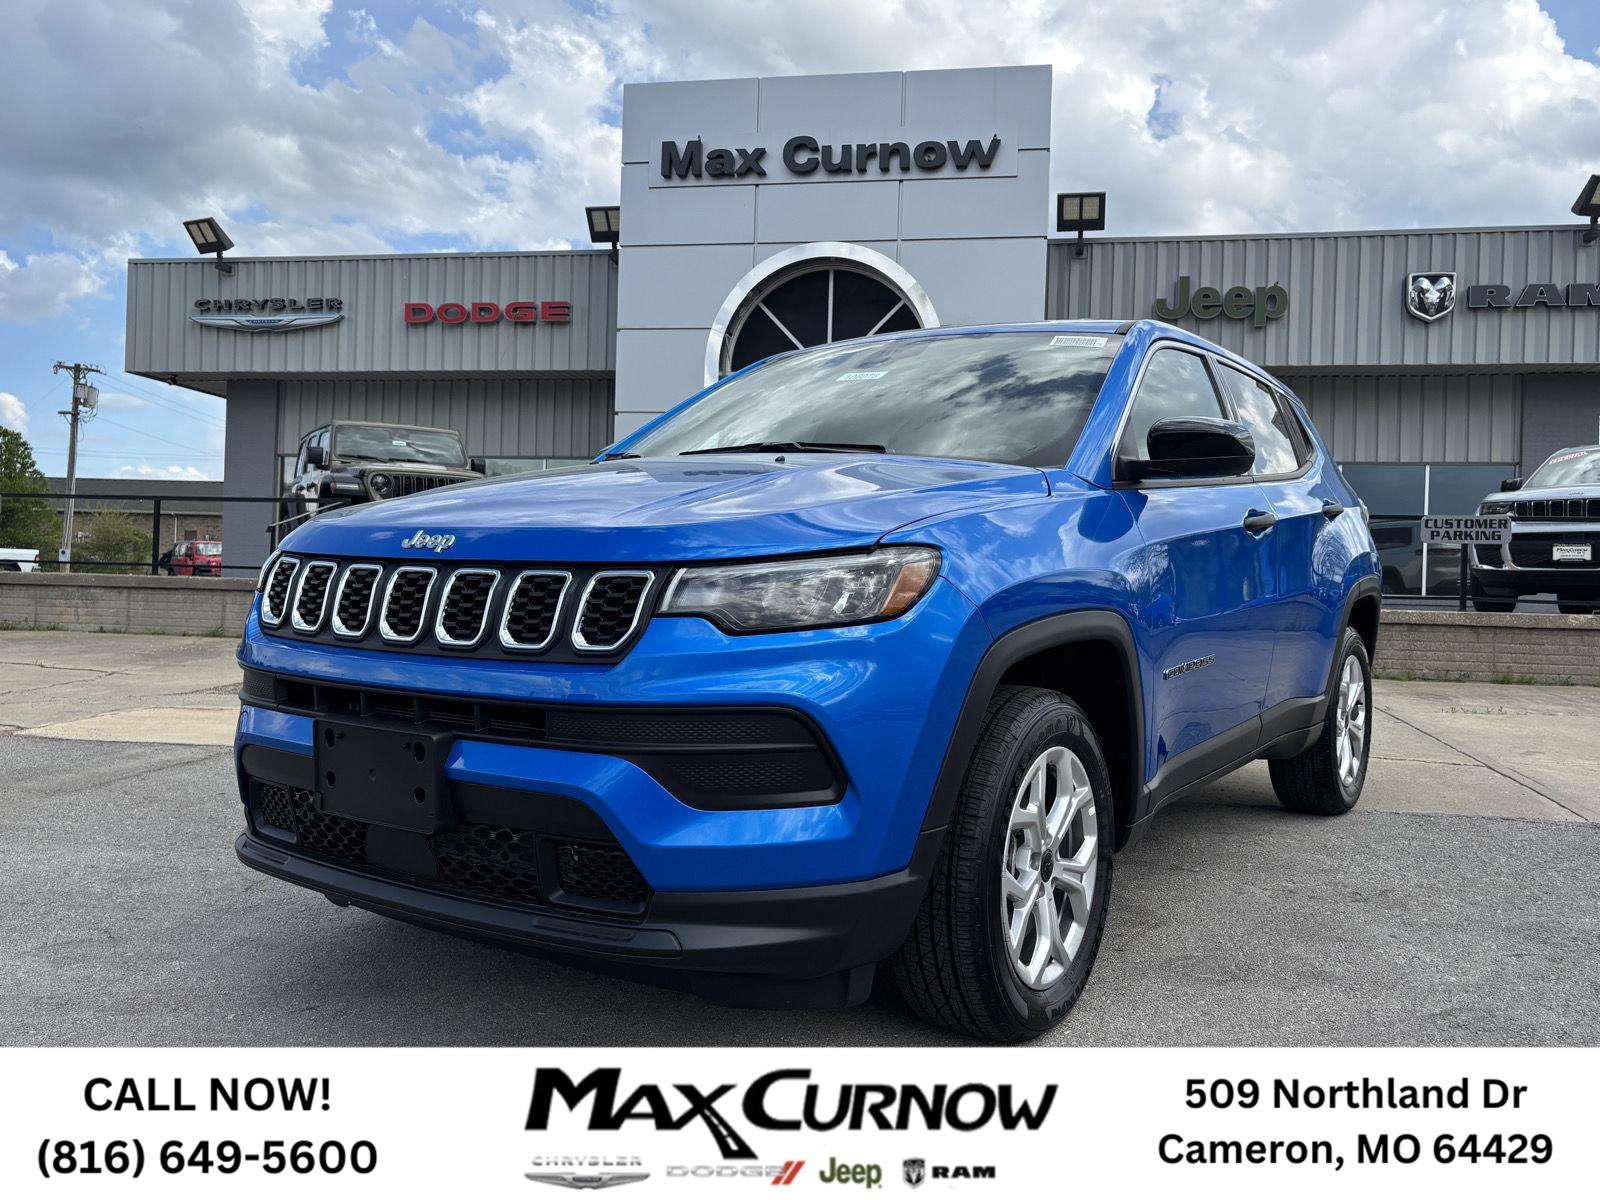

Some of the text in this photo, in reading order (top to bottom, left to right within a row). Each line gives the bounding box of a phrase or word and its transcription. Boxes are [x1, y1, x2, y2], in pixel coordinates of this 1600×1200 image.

[660, 134, 1002, 180] Max Curnow
[194, 297, 344, 312] CHRYSLER
[404, 301, 571, 325] DODGE
[1155, 275, 1290, 327] Jeep
[1424, 518, 1509, 530] CUSTOMER
[1430, 530, 1503, 542] PARKING
[401, 529, 456, 553] Jeep
